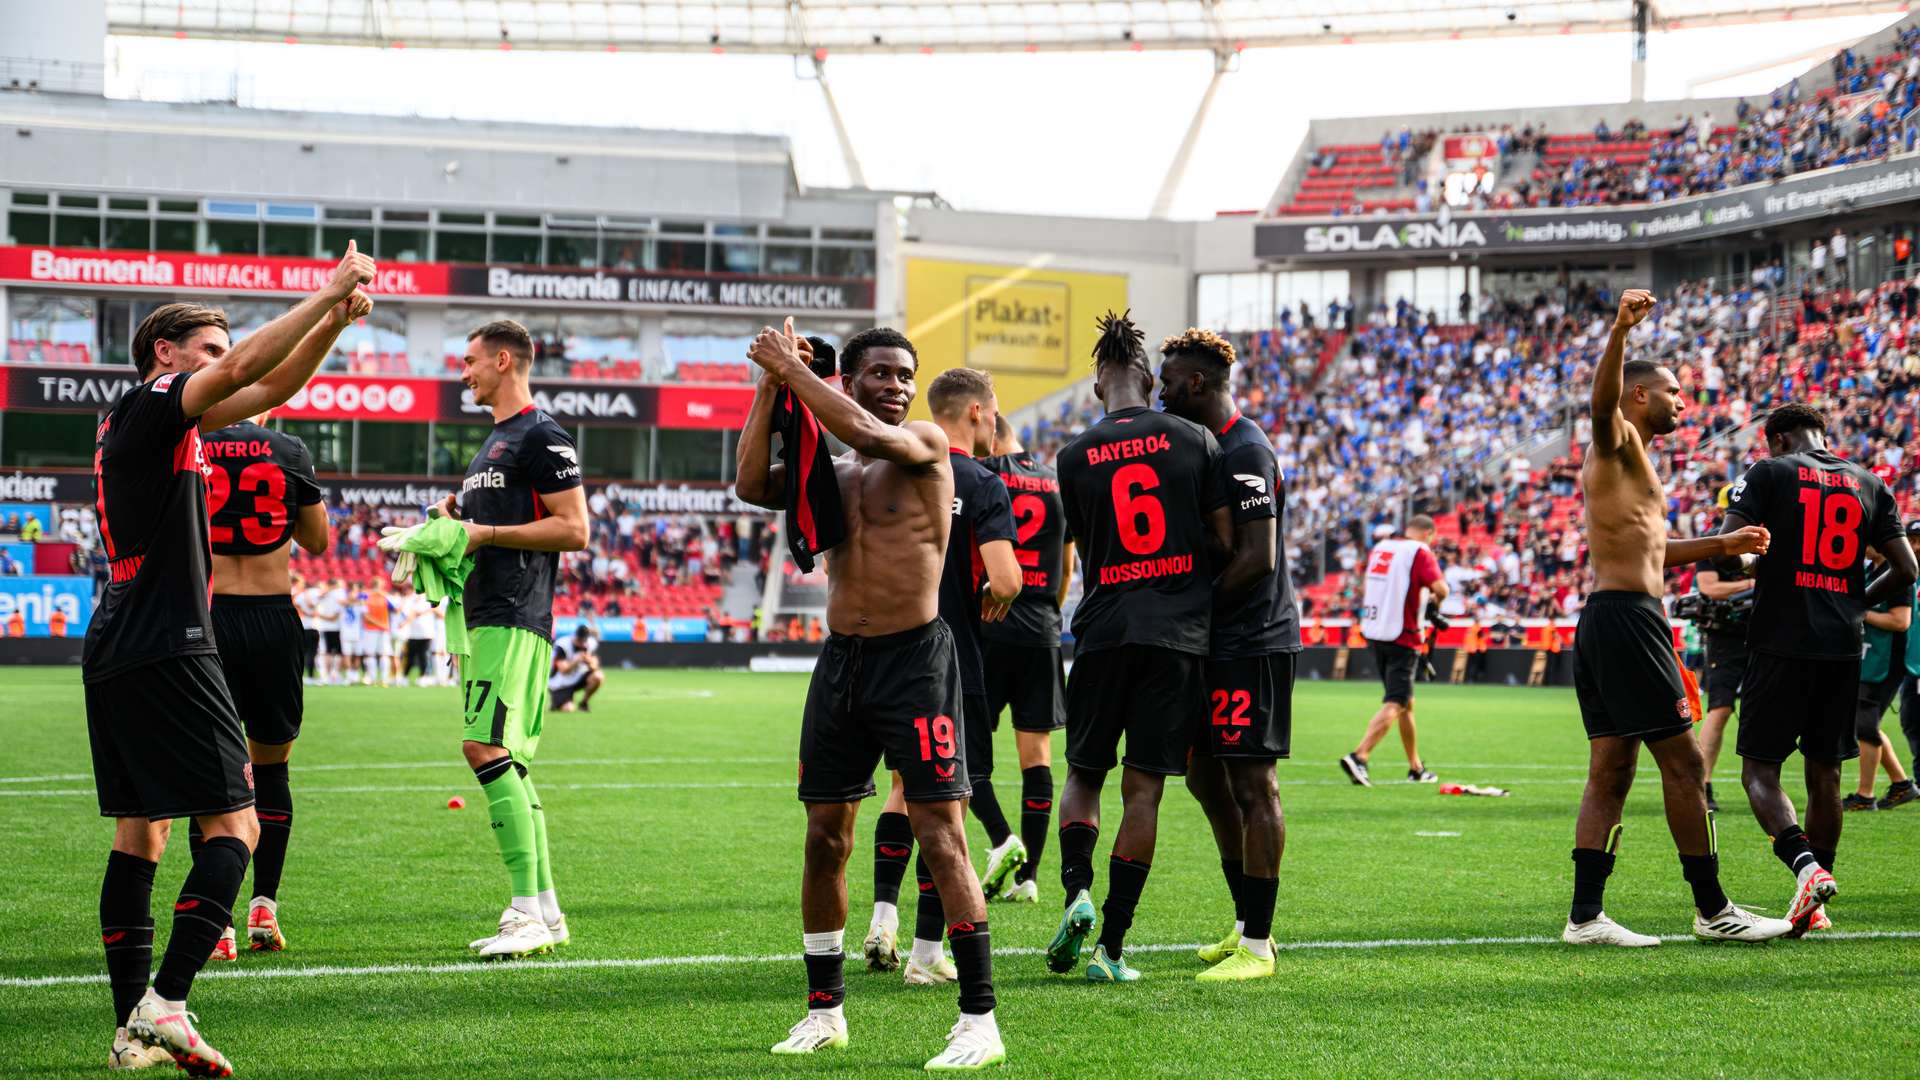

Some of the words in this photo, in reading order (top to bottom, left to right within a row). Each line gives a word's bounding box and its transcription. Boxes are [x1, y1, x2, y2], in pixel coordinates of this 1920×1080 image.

[1304, 221, 1486, 252] SOLARNIA
[31, 249, 174, 285] Barmenia
[183, 262, 277, 288] EINFACH.
[488, 267, 620, 300] Barmenia
[627, 279, 714, 304] EINFACH.
[720, 281, 847, 309] MENSCHLICH.
[461, 389, 637, 419] SARNIA
[203, 441, 248, 457] AYER
[248, 440, 273, 458] 04
[1086, 437, 1146, 466] BAYER
[1145, 432, 1172, 454] 04
[999, 471, 1042, 492] BAYER
[1797, 466, 1843, 489] BAYER
[1841, 474, 1862, 492] 04
[209, 461, 289, 546] 23
[1110, 462, 1167, 556] 6
[1240, 496, 1271, 511] trive
[1012, 493, 1047, 568] 2
[1797, 486, 1864, 571] 18
[1100, 554, 1193, 586] KOSSOUNOU
[1794, 571, 1849, 594] MBAMBA
[464, 680, 492, 713] 17
[1211, 689, 1251, 726] 22
[913, 714, 957, 762] 19
